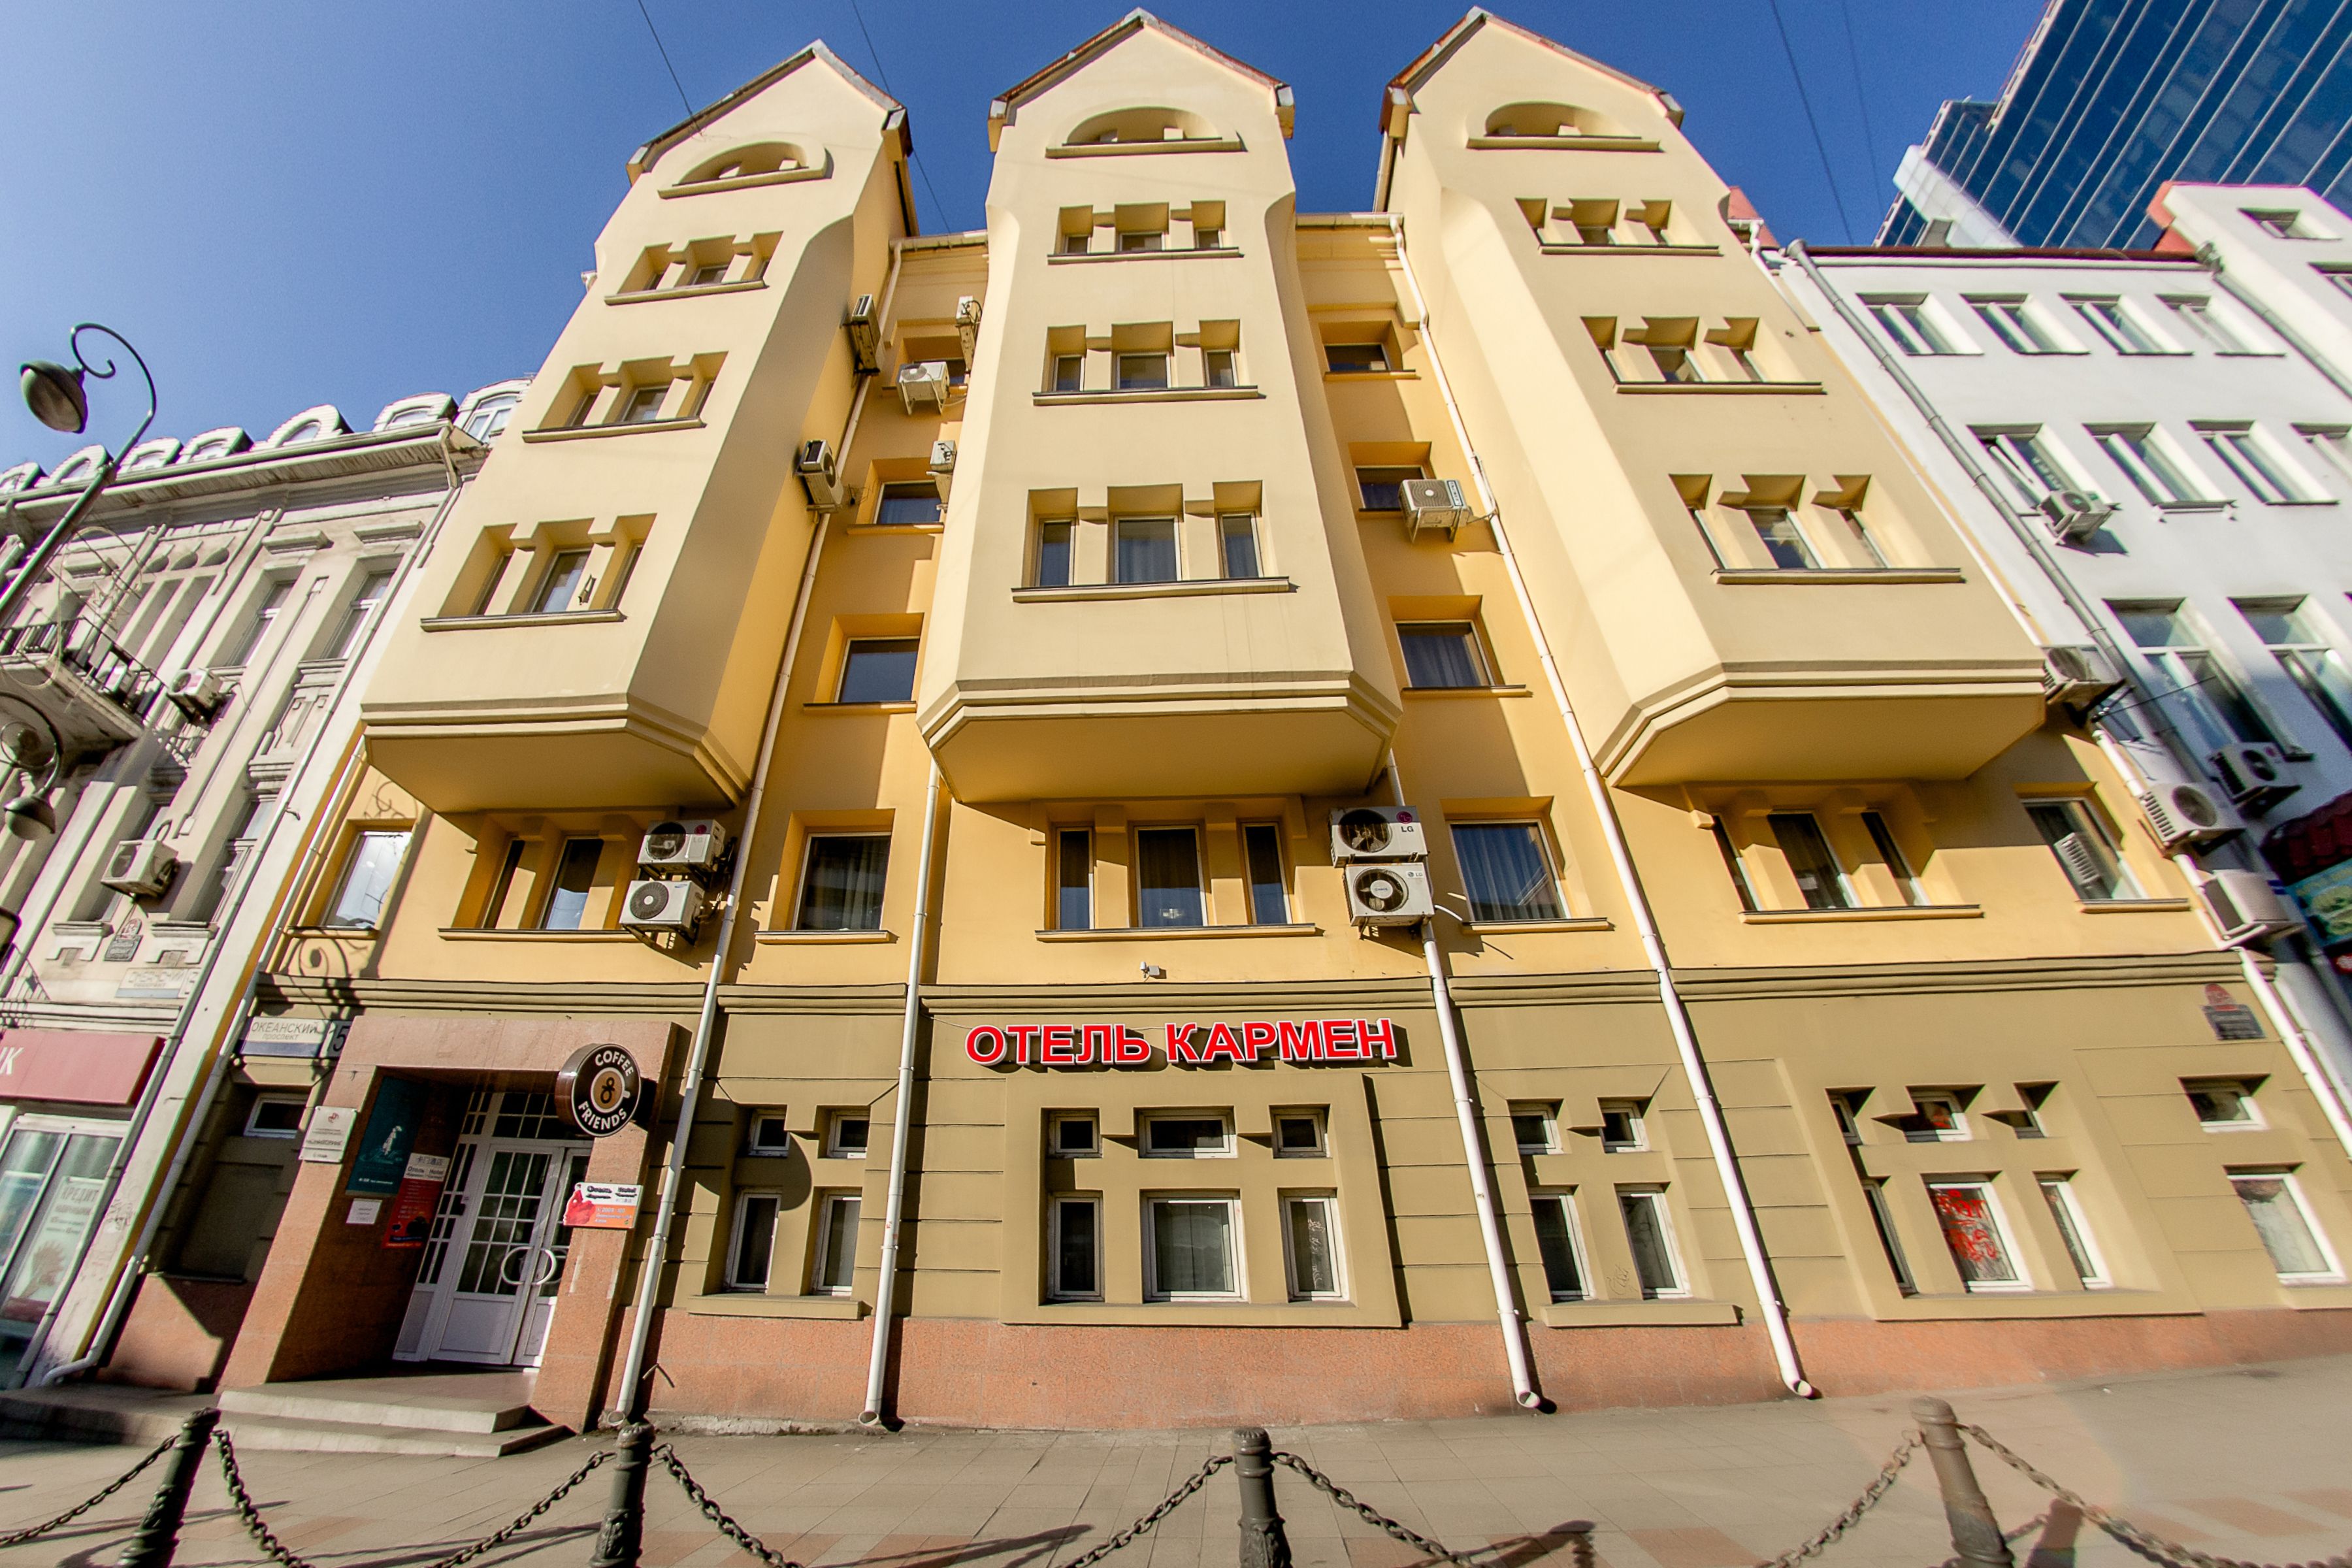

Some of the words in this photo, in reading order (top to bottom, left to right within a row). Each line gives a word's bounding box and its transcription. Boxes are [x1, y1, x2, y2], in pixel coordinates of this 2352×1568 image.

[251, 1021, 318, 1034] ОКЕАНСКИЙ
[965, 1024, 1151, 1066] ОТЕЛЬ
[1165, 1017, 1398, 1064] КАРМЕН
[595, 1050, 634, 1077] COFFEE
[578, 1101, 627, 1130] FRIENDS
